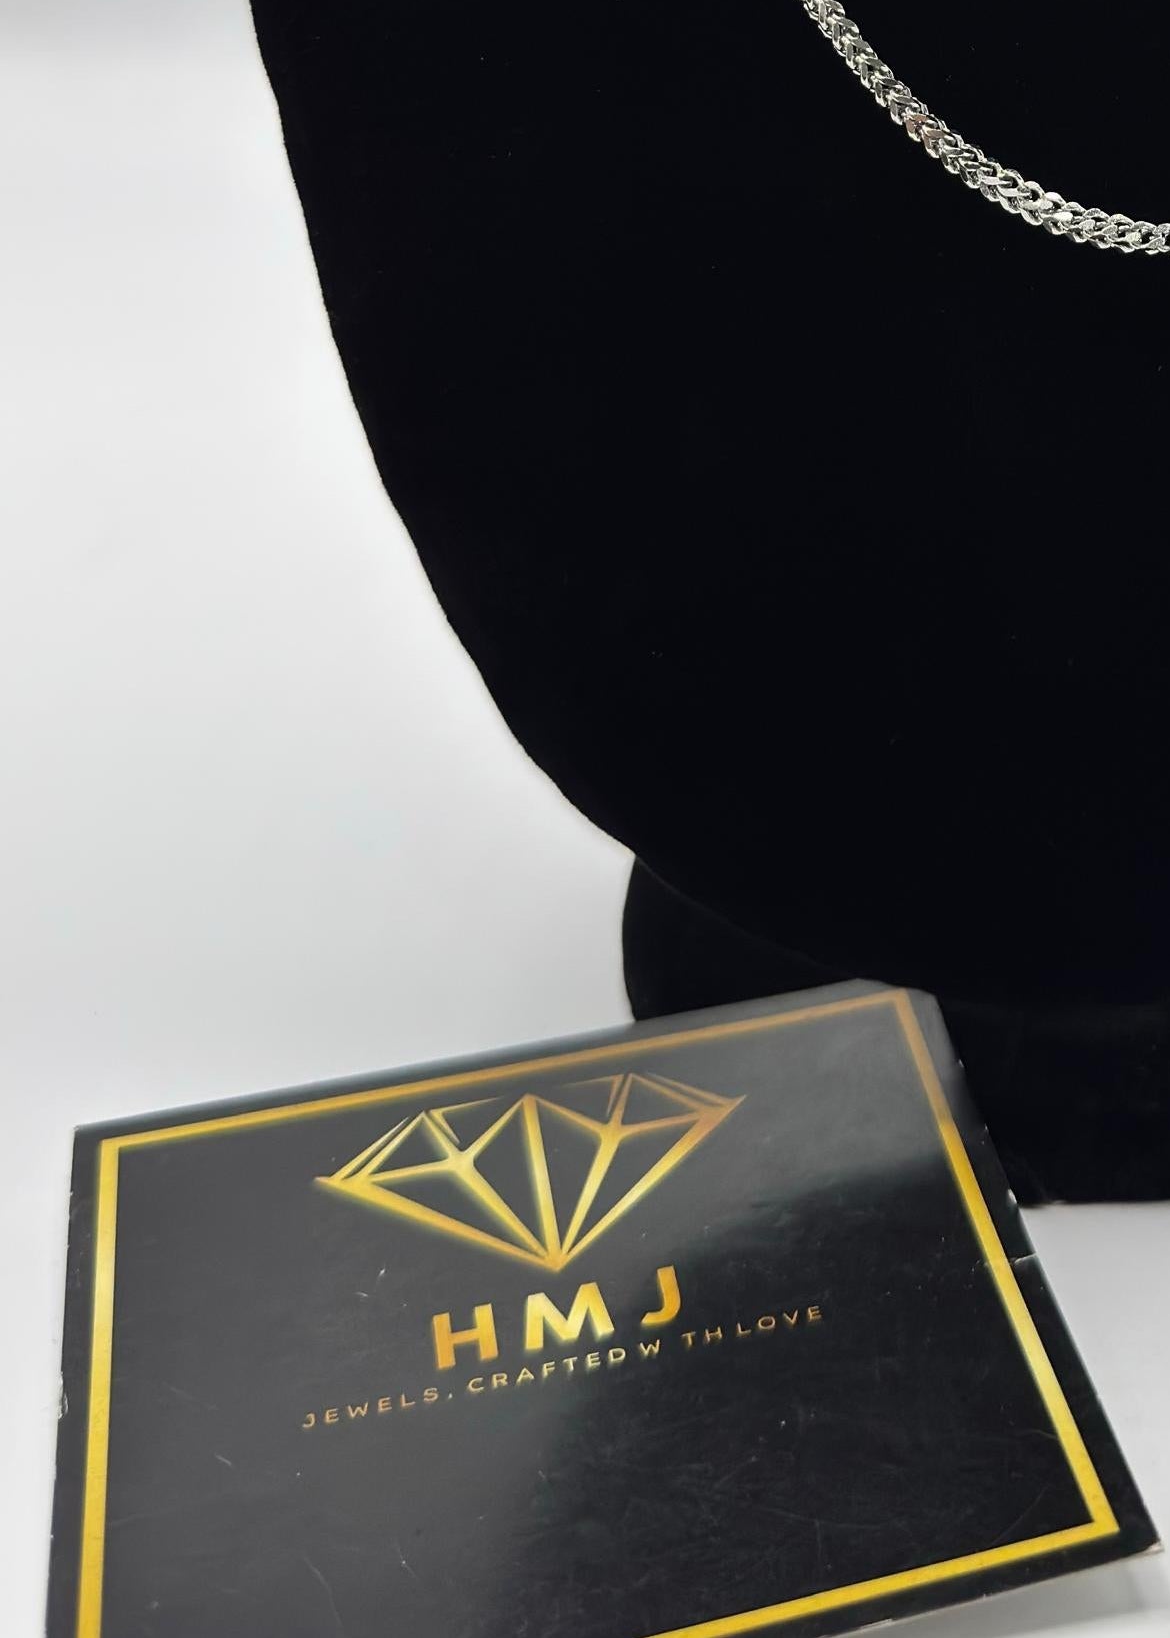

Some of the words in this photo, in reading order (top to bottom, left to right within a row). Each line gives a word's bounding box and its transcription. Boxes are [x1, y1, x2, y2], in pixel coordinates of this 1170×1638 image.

[467, 1347, 627, 1394] CRAFTED
[639, 1325, 723, 1357] WTH
[736, 1305, 824, 1336] LOVE
